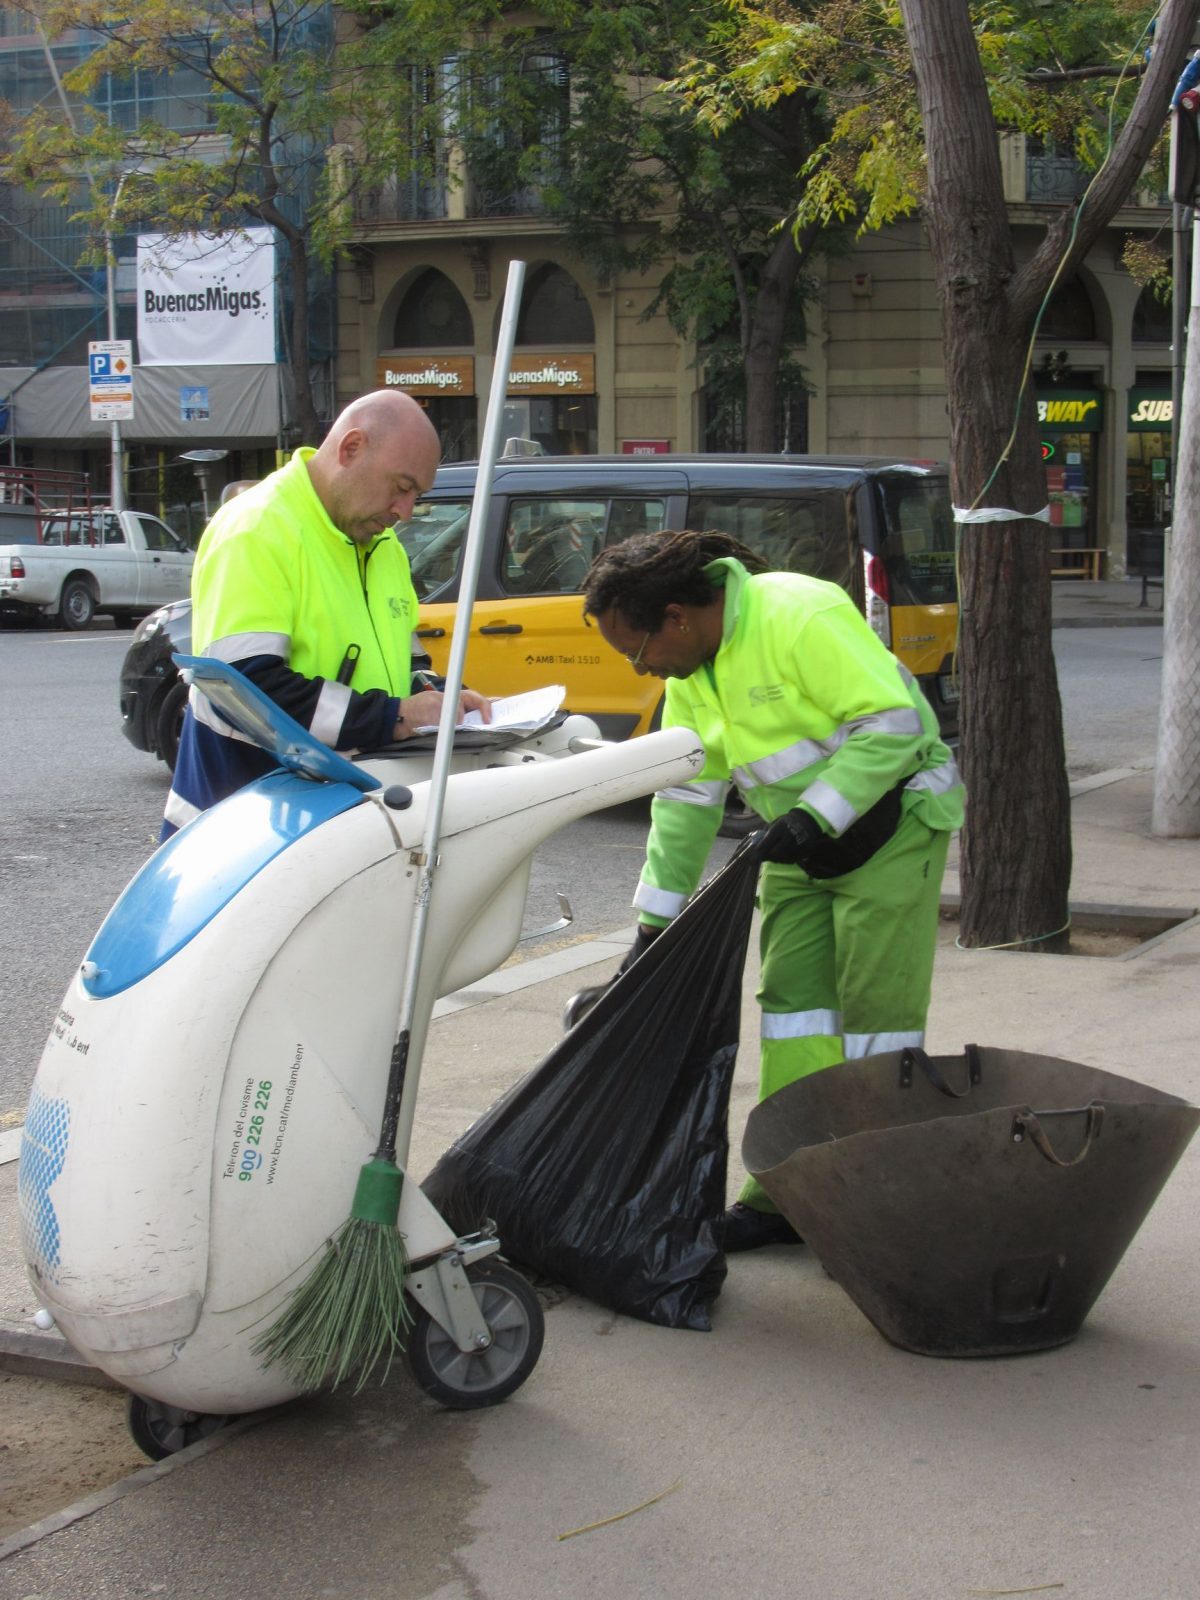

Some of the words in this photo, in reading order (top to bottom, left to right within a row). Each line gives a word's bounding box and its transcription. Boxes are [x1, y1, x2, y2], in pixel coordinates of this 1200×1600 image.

[509, 368, 578, 387] uenasMigas
[1037, 400, 1097, 422] BWAY
[1131, 400, 1173, 422] SUB
[535, 655, 554, 664] AMB
[577, 655, 600, 665] 1510
[233, 1120, 245, 1138] del
[239, 1078, 254, 1118] civisme
[255, 1080, 273, 1111] 226
[247, 1115, 265, 1146] 226
[238, 1149, 257, 1182] 900
